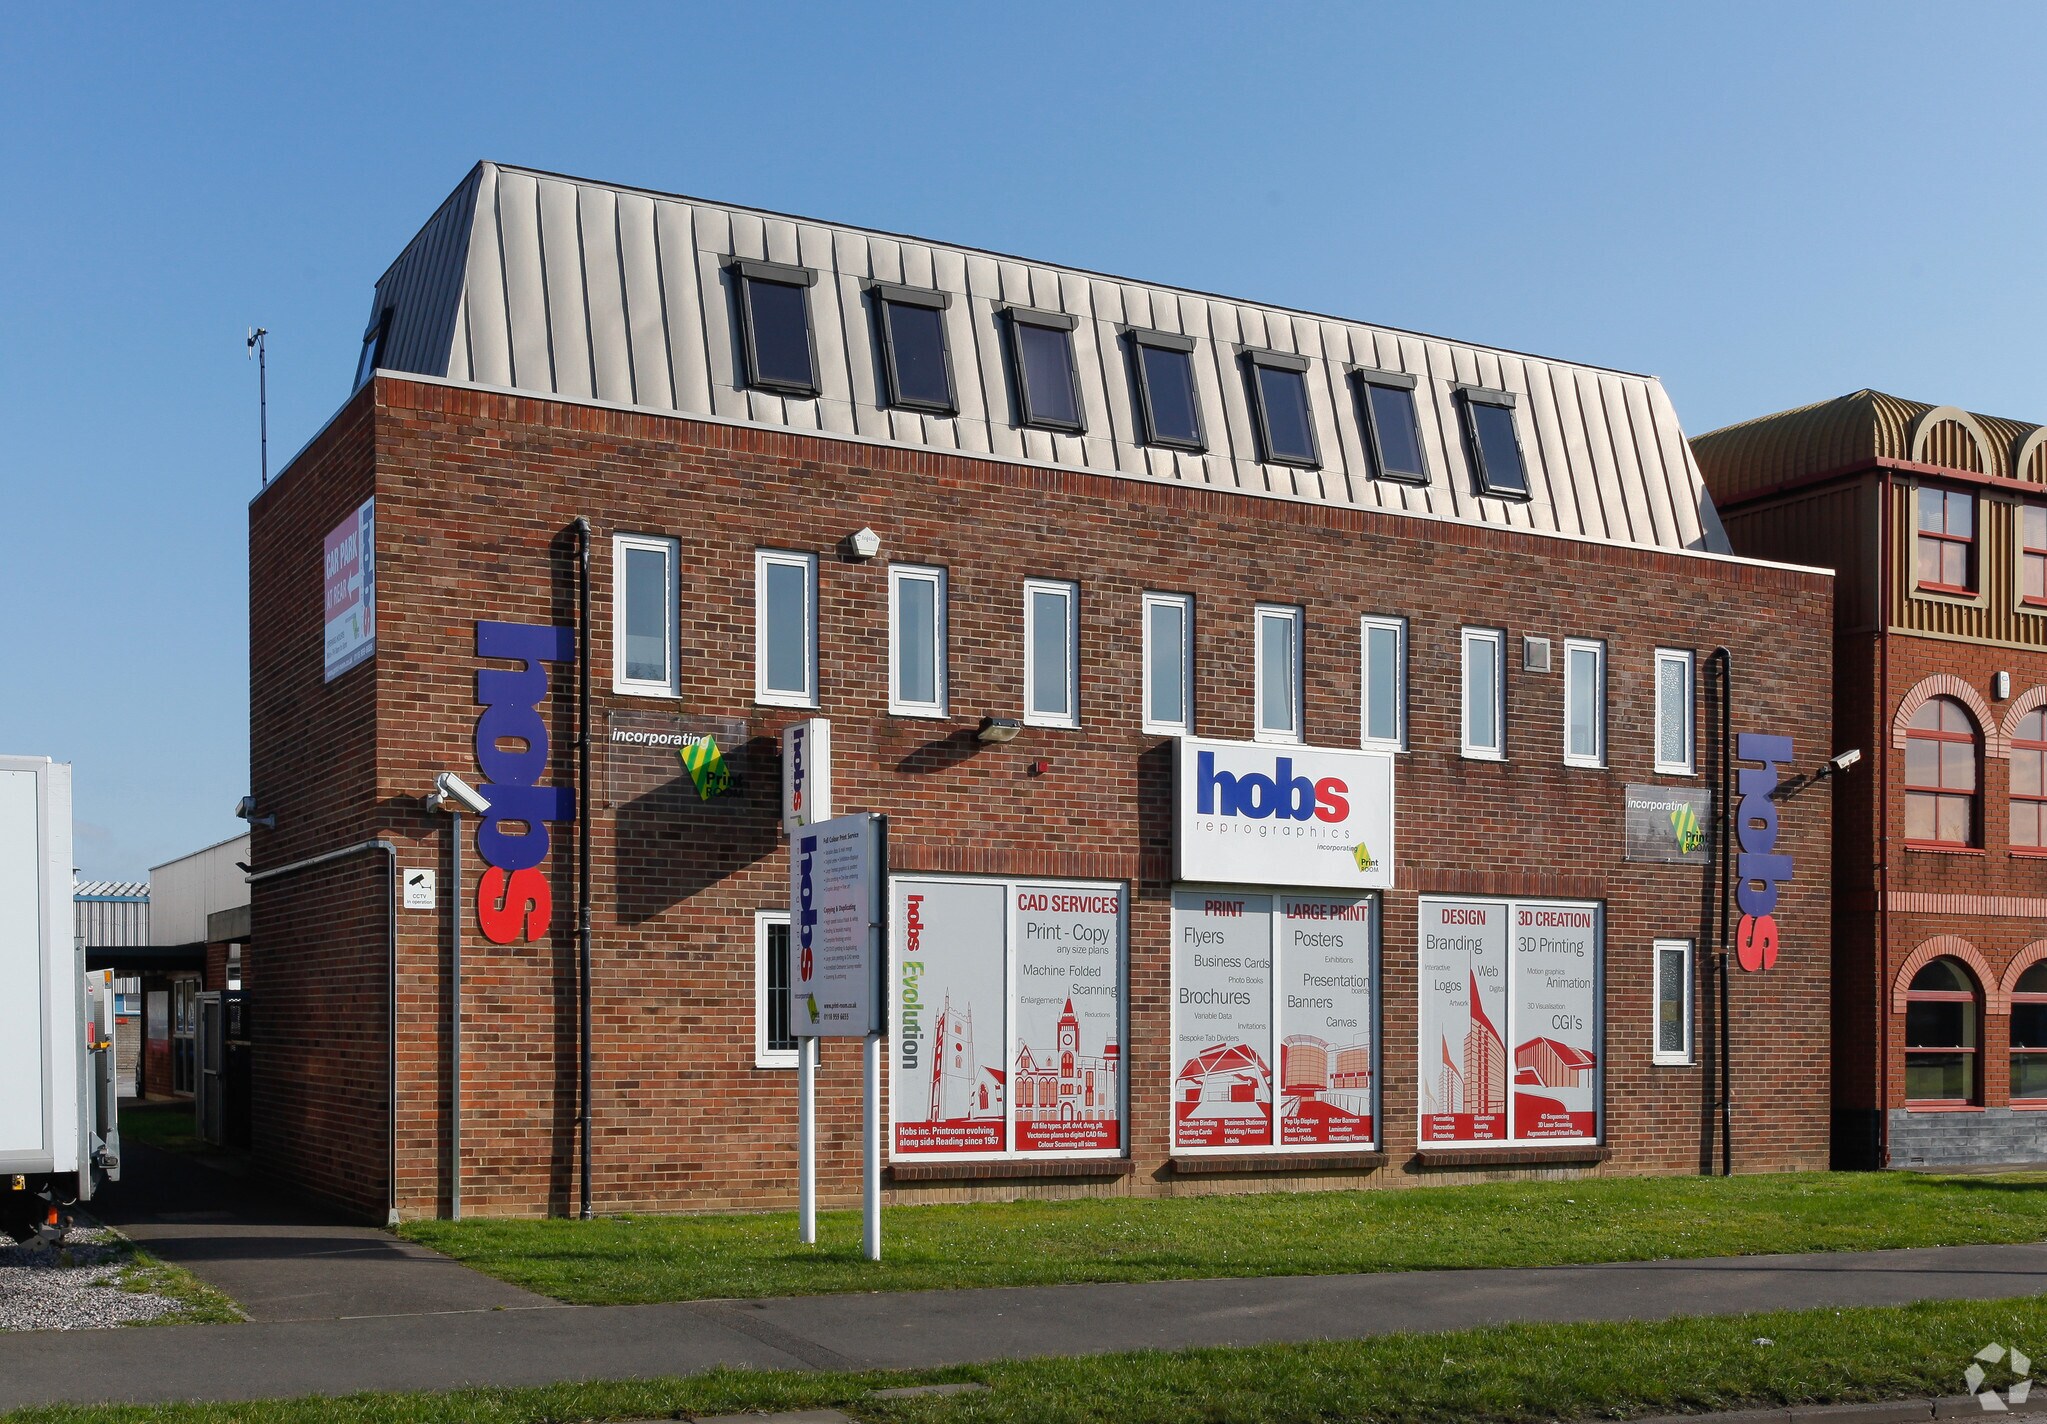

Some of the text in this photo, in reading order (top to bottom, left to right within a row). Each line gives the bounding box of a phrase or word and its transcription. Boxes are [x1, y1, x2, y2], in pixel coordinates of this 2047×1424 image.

[326, 530, 358, 579] CAR PARK
[363, 505, 374, 637] hobs
[327, 578, 347, 611] AT REAR
[612, 728, 710, 750] incorporating
[794, 728, 804, 811] hobs
[477, 620, 576, 944] hobs
[706, 772, 744, 788] Print
[1197, 751, 1350, 823] hobs
[1628, 798, 1688, 813] incorporating
[1196, 820, 1350, 839] reprographics
[1686, 831, 1708, 842] Print
[1317, 843, 1358, 853] incorporating
[1738, 732, 1792, 972] hobs
[801, 836, 817, 982] hobs
[1018, 894, 1118, 914] CAD SERVICES
[1205, 900, 1244, 917] PRINT
[1287, 903, 1367, 921] LARGE PRINT
[908, 894, 924, 951] hobs
[1442, 909, 1486, 925] DESIGN
[1518, 911, 1590, 928] 3D CREATION
[1027, 922, 1061, 940] Print
[1073, 924, 1110, 945] Copy
[1185, 927, 1224, 947] Flyers
[1294, 930, 1343, 947] Posters
[1057, 945, 1109, 955] any size plans
[1427, 934, 1482, 955] Branding
[1518, 937, 1584, 957] 3D Printing
[1194, 955, 1271, 968] Business Cards
[1023, 964, 1101, 977] Machine Folded
[1478, 966, 1498, 977] Web
[1304, 973, 1369, 987] Presentation
[1435, 980, 1461, 993] Logos
[1546, 977, 1590, 988] Animation
[1072, 984, 1117, 998] Scanning
[1180, 988, 1250, 1004] Brochures
[1021, 996, 1063, 1005] Enlargements
[1288, 995, 1333, 1008] Banners
[902, 962, 924, 1069] Evolution
[1326, 1017, 1357, 1027] Canvas
[1552, 1015, 1582, 1030] CGI's
[900, 1127, 917, 1135] Hobs
[932, 1126, 965, 1135] Printroom
[966, 1126, 994, 1136] evolving
[900, 1138, 918, 1147] along
[936, 1137, 963, 1146] Reading
[964, 1137, 982, 1145] since
[984, 1136, 998, 1144] 1967
